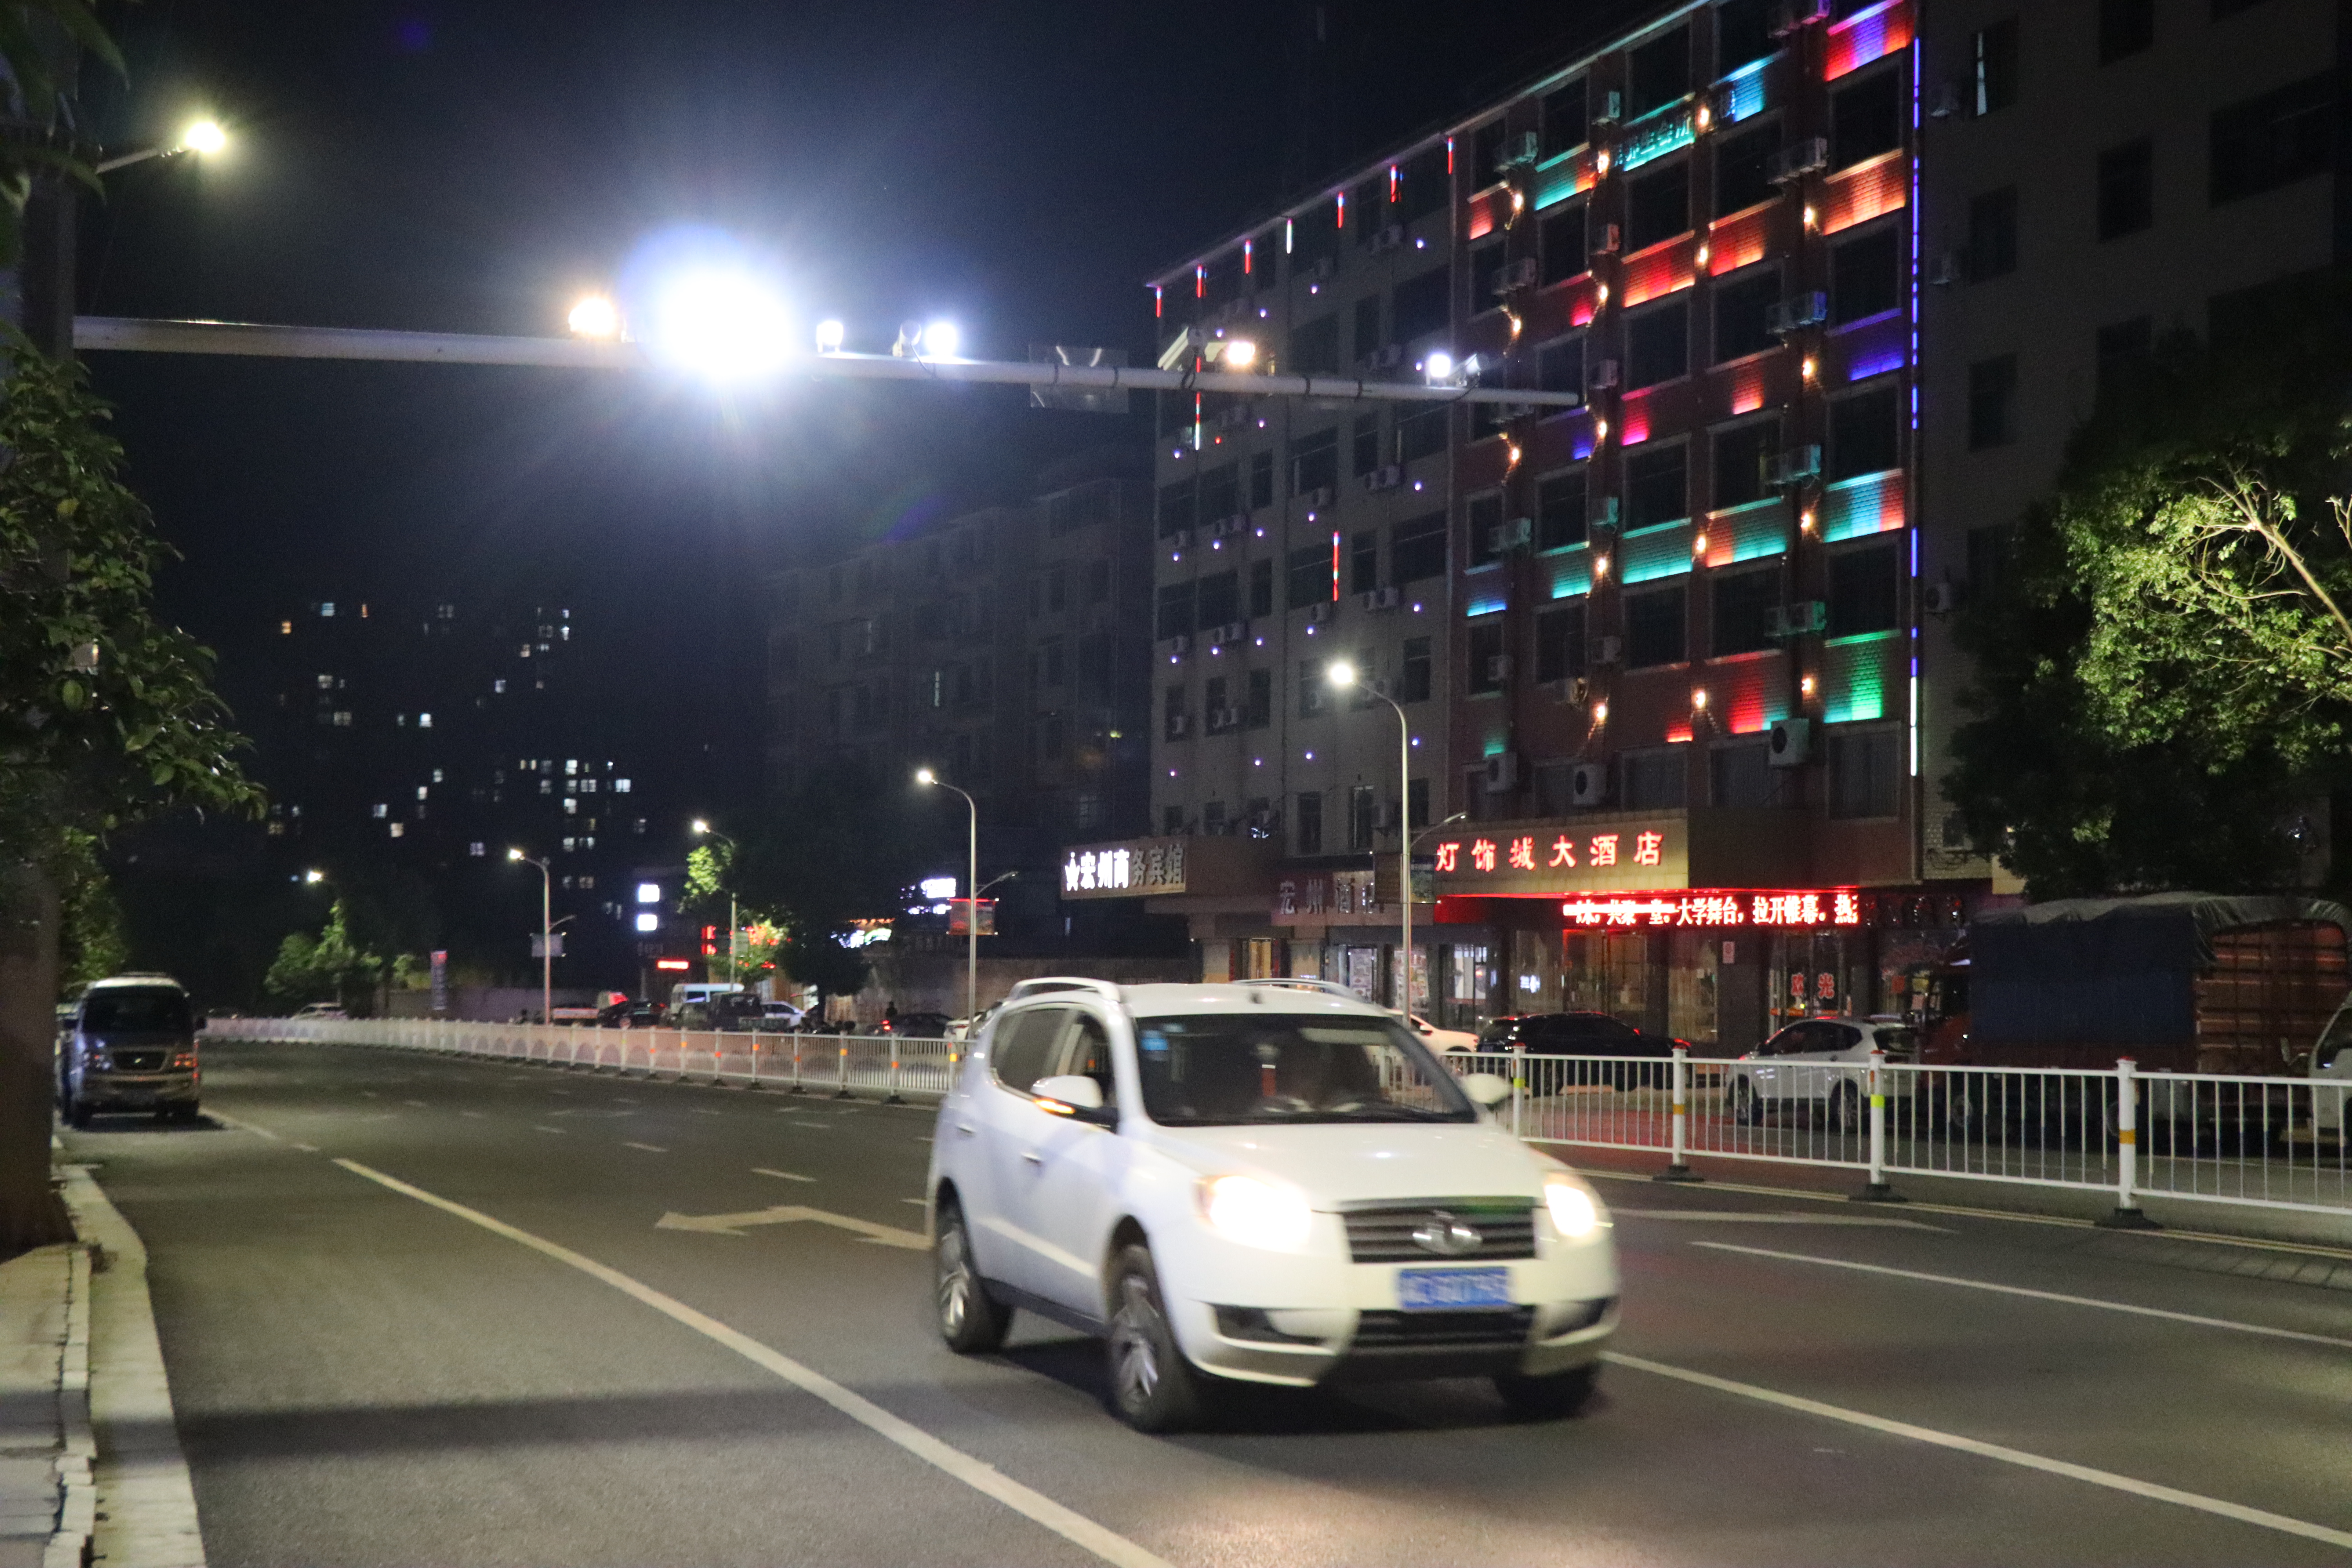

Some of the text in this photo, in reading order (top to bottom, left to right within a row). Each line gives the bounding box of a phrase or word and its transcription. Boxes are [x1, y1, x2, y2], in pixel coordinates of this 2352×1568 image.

[1080, 843, 1184, 889] 宏州商务宾馆
[1435, 830, 1663, 872] 灯饰城大酒店
